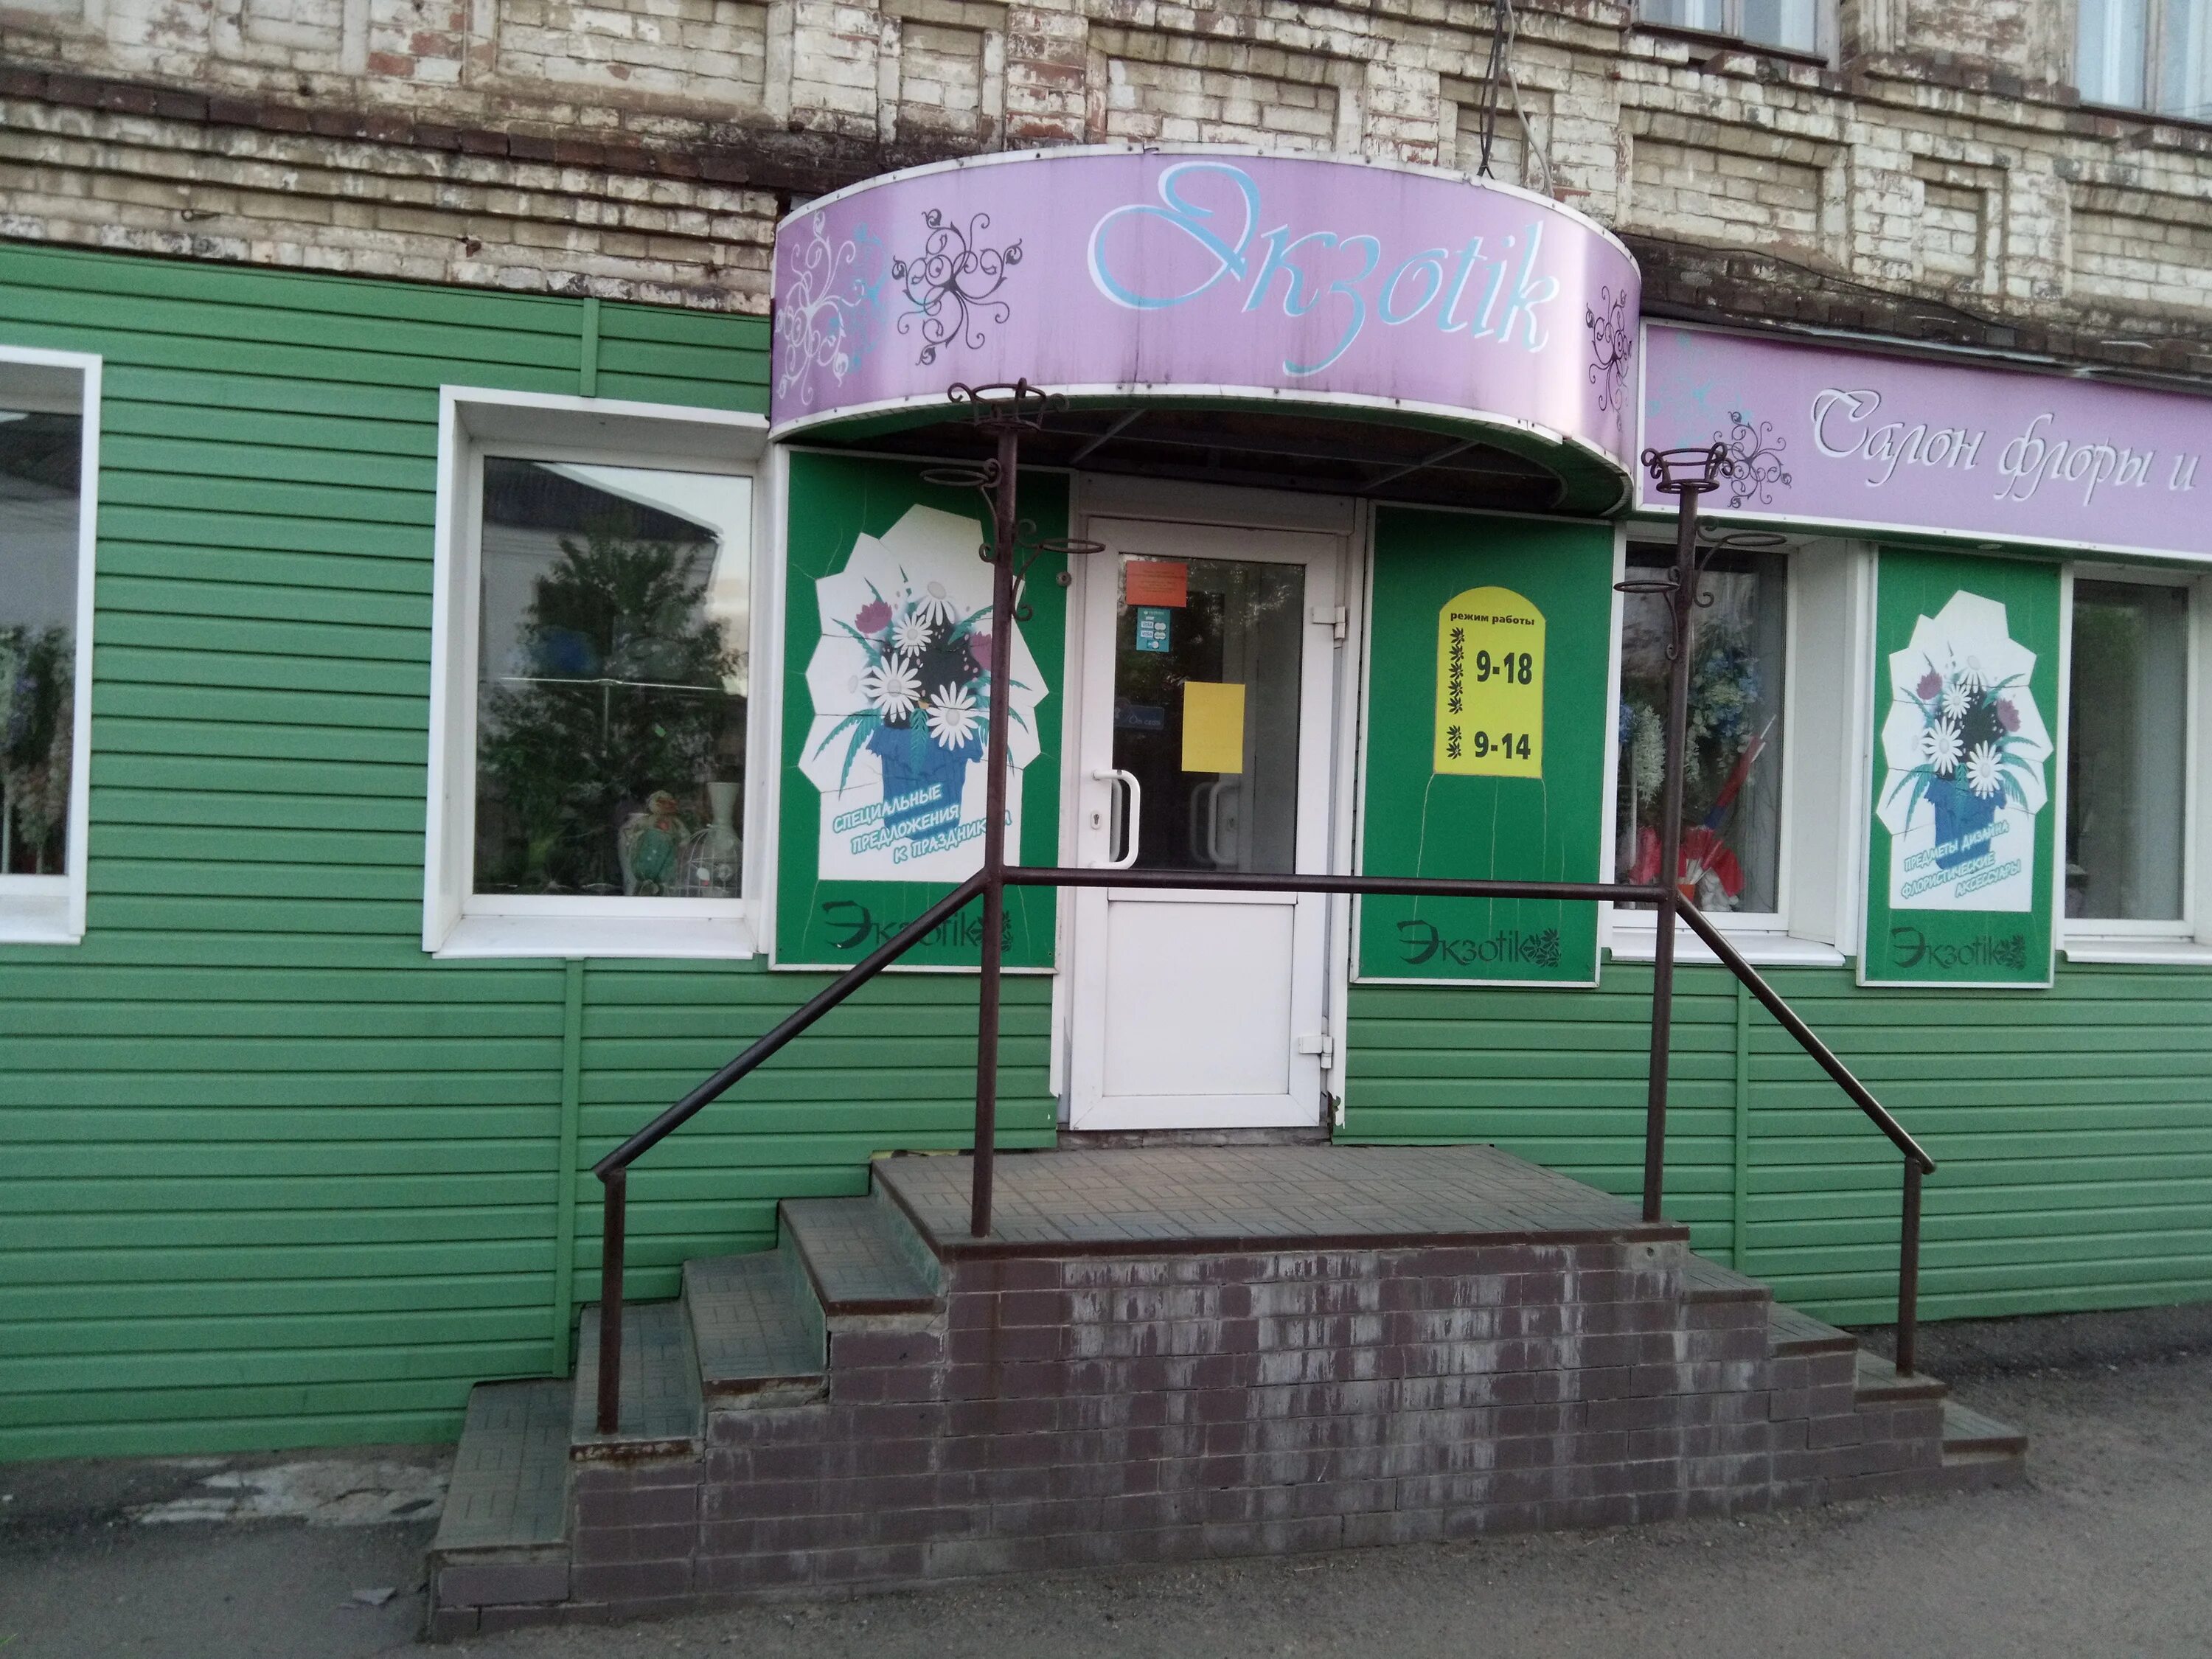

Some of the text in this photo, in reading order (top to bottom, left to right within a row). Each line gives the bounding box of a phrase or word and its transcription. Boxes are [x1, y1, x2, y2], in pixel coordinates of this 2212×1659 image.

[1811, 388, 2201, 506] Салон флоры и
[1450, 613, 1534, 625] режим работы
[1476, 650, 1533, 685] 9-18
[1474, 731, 1531, 759] 9-14
[833, 783, 943, 832] СПЕЦИАЛЬНЫЕ
[851, 804, 960, 854] ПРЕДЛОЖЕНИЯ
[894, 810, 1012, 863] К ПРАЗДНИК
[1905, 820, 2009, 872] ПРЕДМЕТЫ ДИЗАЙНА
[1901, 851, 1995, 899] ФЛОРИСТИЧЕСКИЕ
[1955, 859, 2021, 897] АКСЕССУАРЫ
